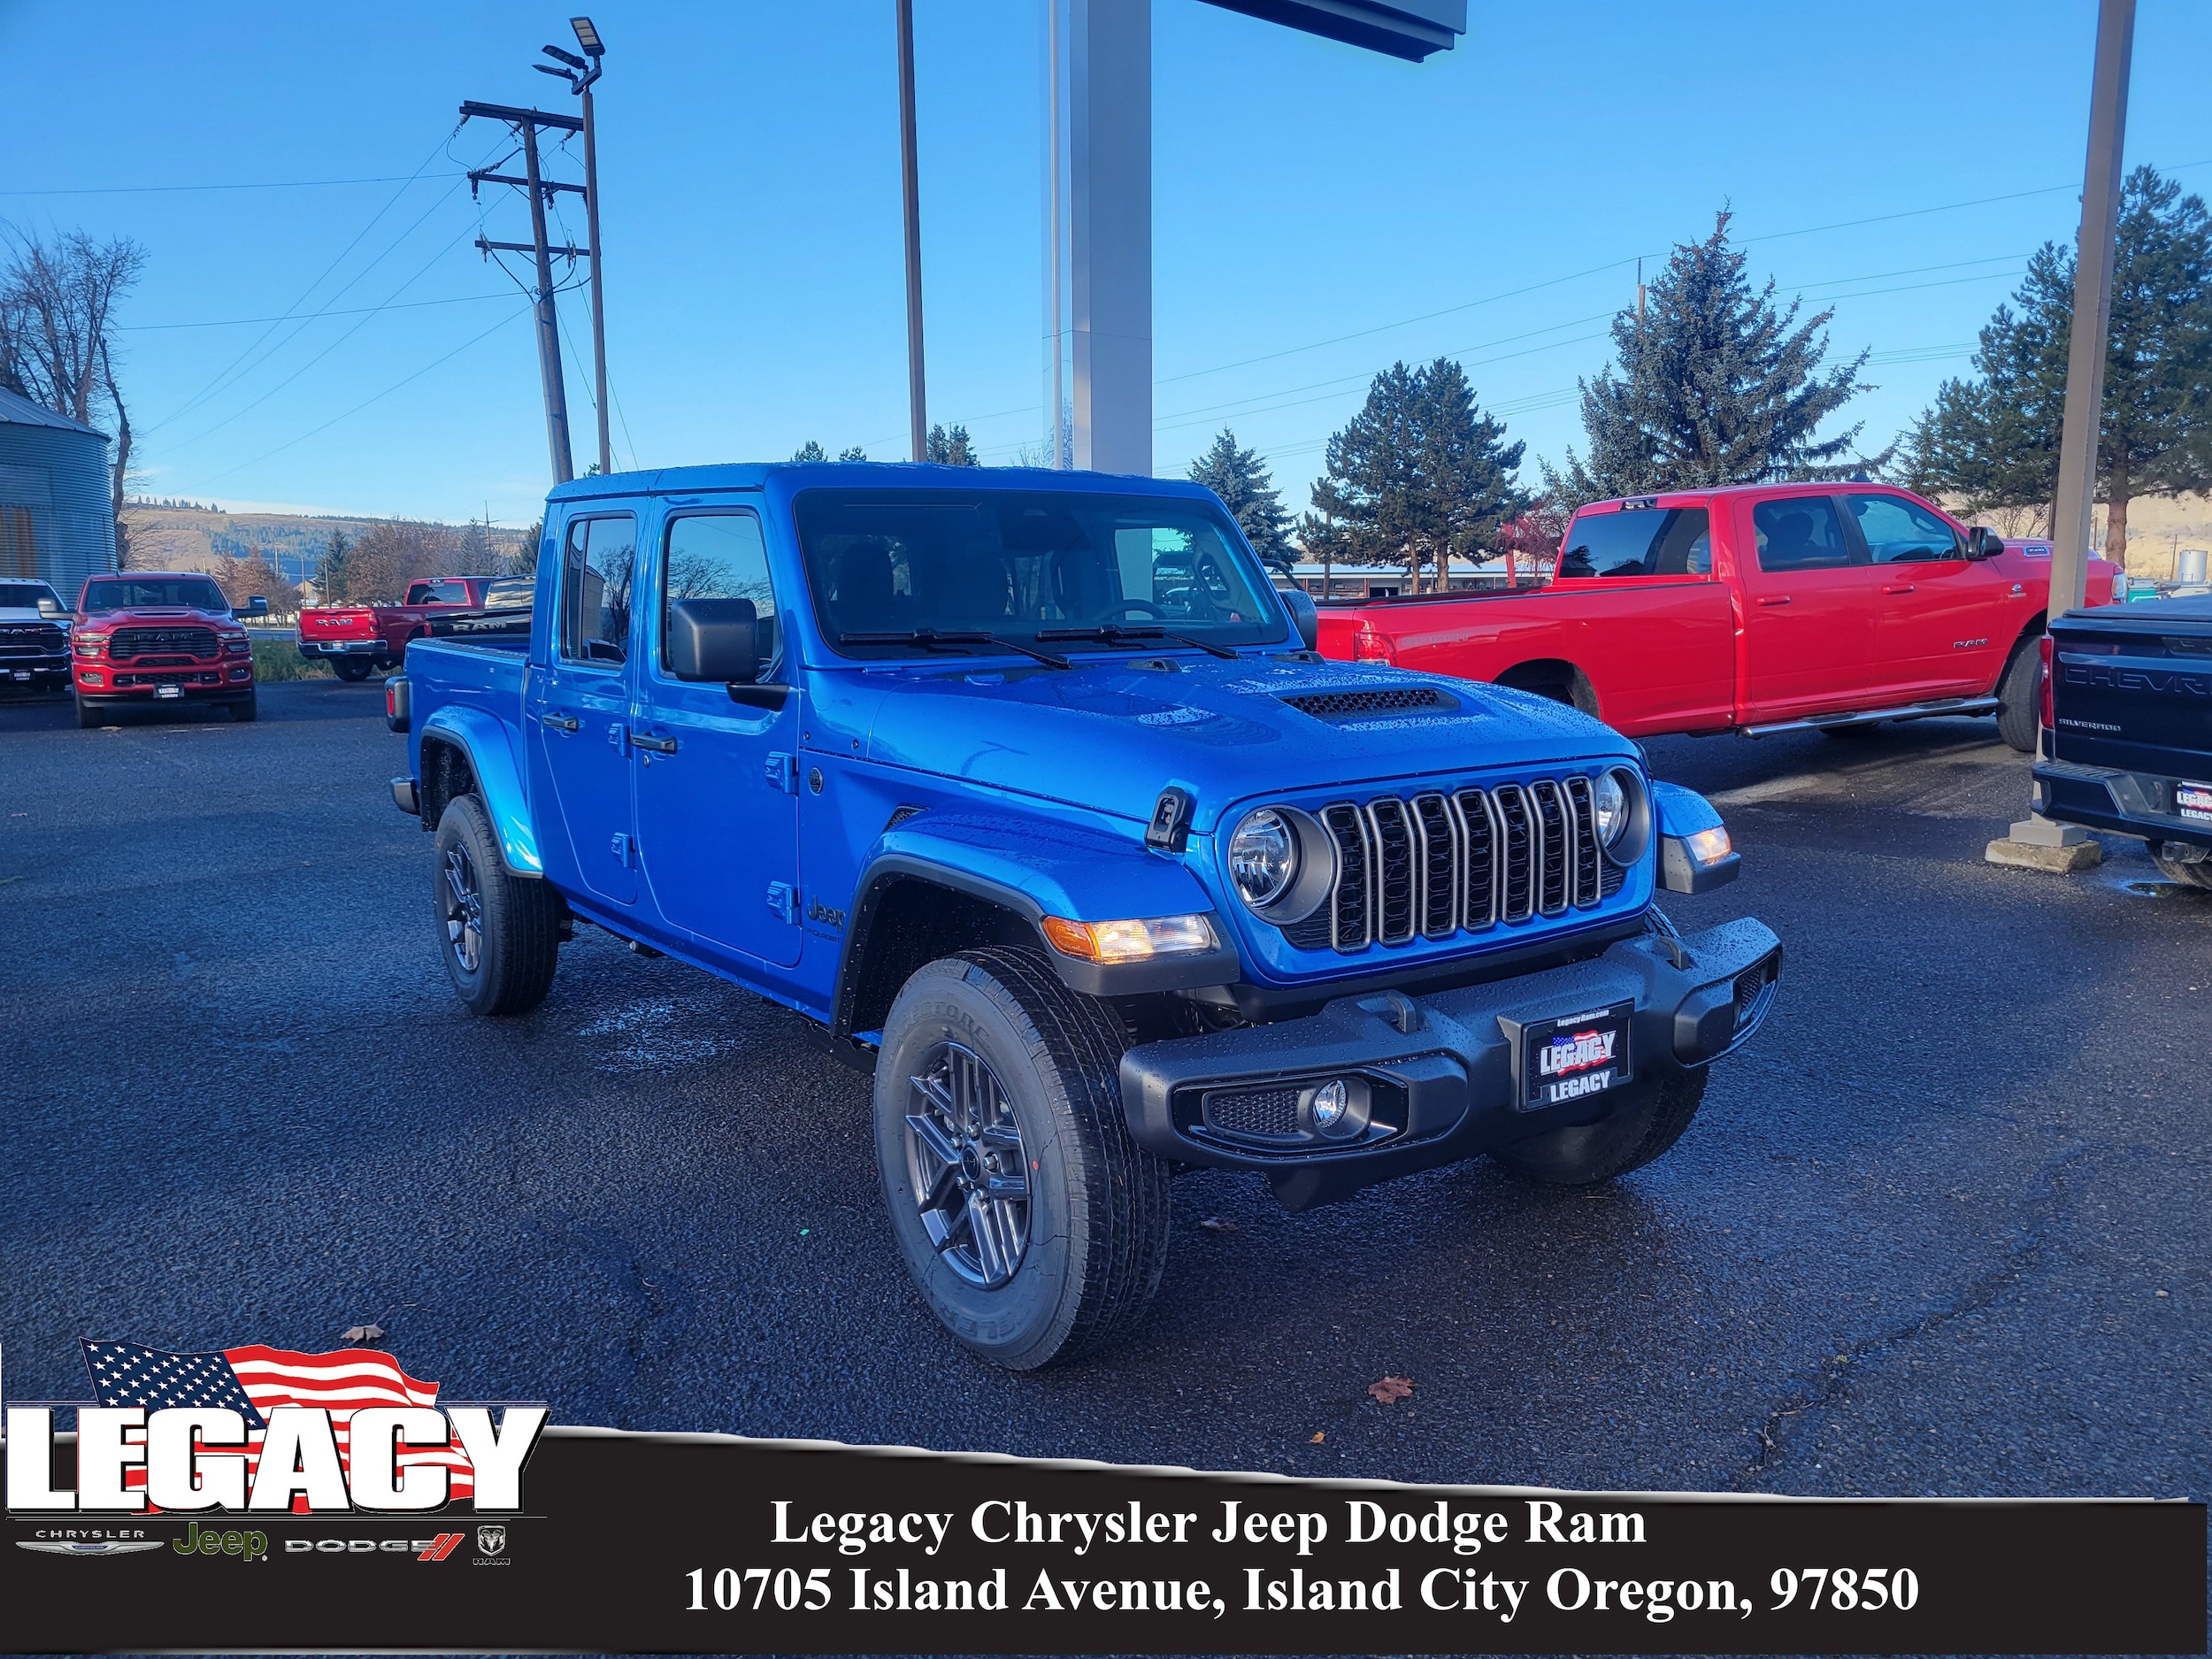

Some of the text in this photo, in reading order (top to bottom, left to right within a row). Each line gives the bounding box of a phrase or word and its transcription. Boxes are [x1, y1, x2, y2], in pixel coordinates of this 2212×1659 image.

[315, 618, 353, 627] RAM
[453, 621, 507, 632] RAM
[1954, 638, 1988, 649] RAM
[2065, 666, 2212, 695] CHEVR
[2058, 718, 2122, 732] SILVERADO
[808, 895, 847, 933] Jeep
[1540, 1033, 1617, 1074] LEGACY
[1550, 1071, 1611, 1102] LEGACY
